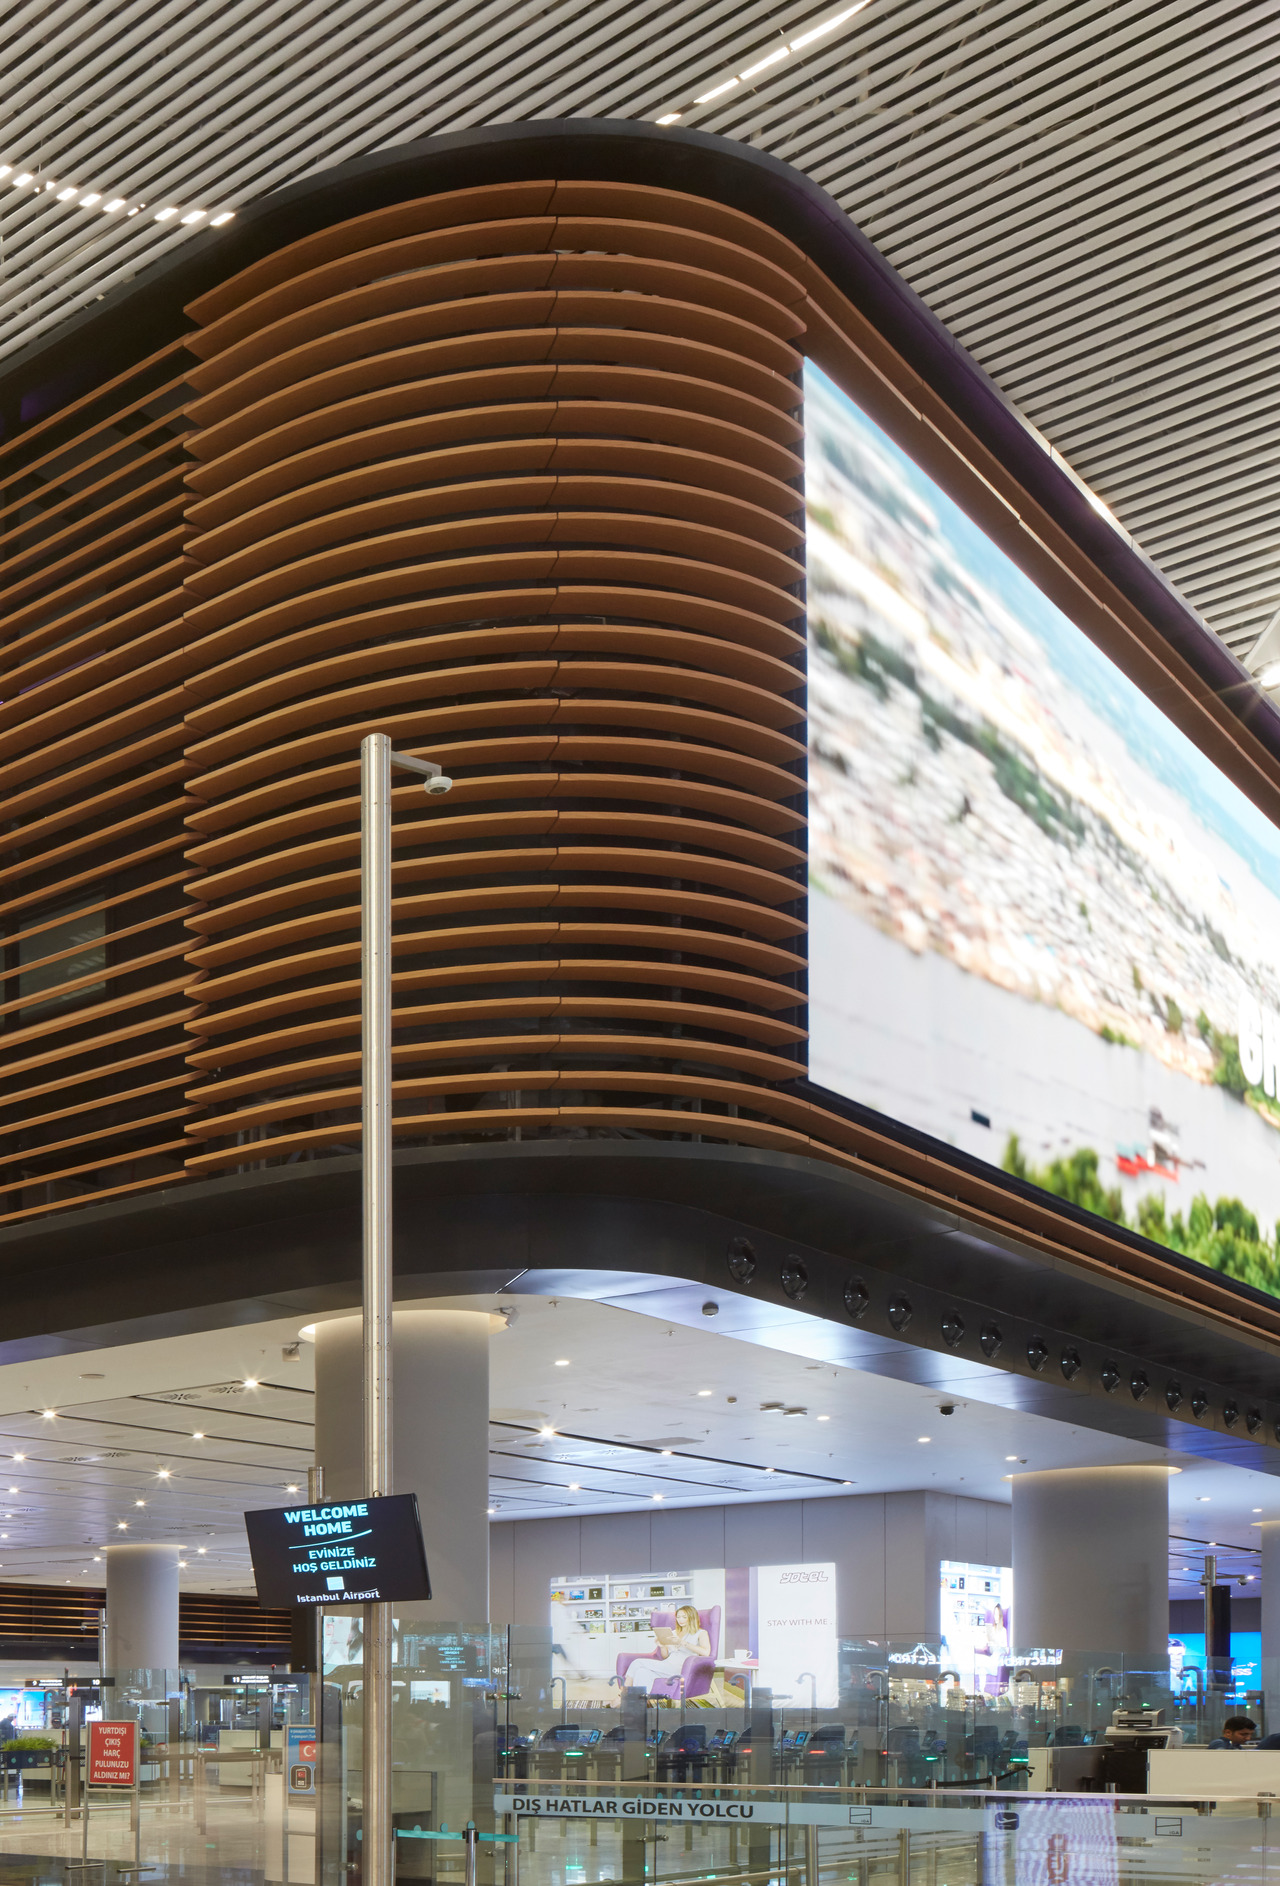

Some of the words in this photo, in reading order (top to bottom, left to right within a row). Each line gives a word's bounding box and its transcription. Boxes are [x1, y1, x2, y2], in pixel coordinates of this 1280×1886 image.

[283, 1503, 369, 1524] WELCOME
[303, 1520, 353, 1537] HOME
[308, 1546, 356, 1560] EVİNİZE
[292, 1562, 318, 1573] HOŞ
[320, 1556, 377, 1571] GELDİNİZ
[296, 1593, 340, 1603] Istanbul
[342, 1590, 381, 1601] Airport
[103, 1749, 121, 1759] HARÇ
[95, 1761, 129, 1769] PULUNUZU
[512, 1798, 541, 1814] DIŞ
[546, 1799, 618, 1814] HATLAR
[622, 1799, 683, 1816] GİDEN
[687, 1803, 754, 1819] YOLCU
